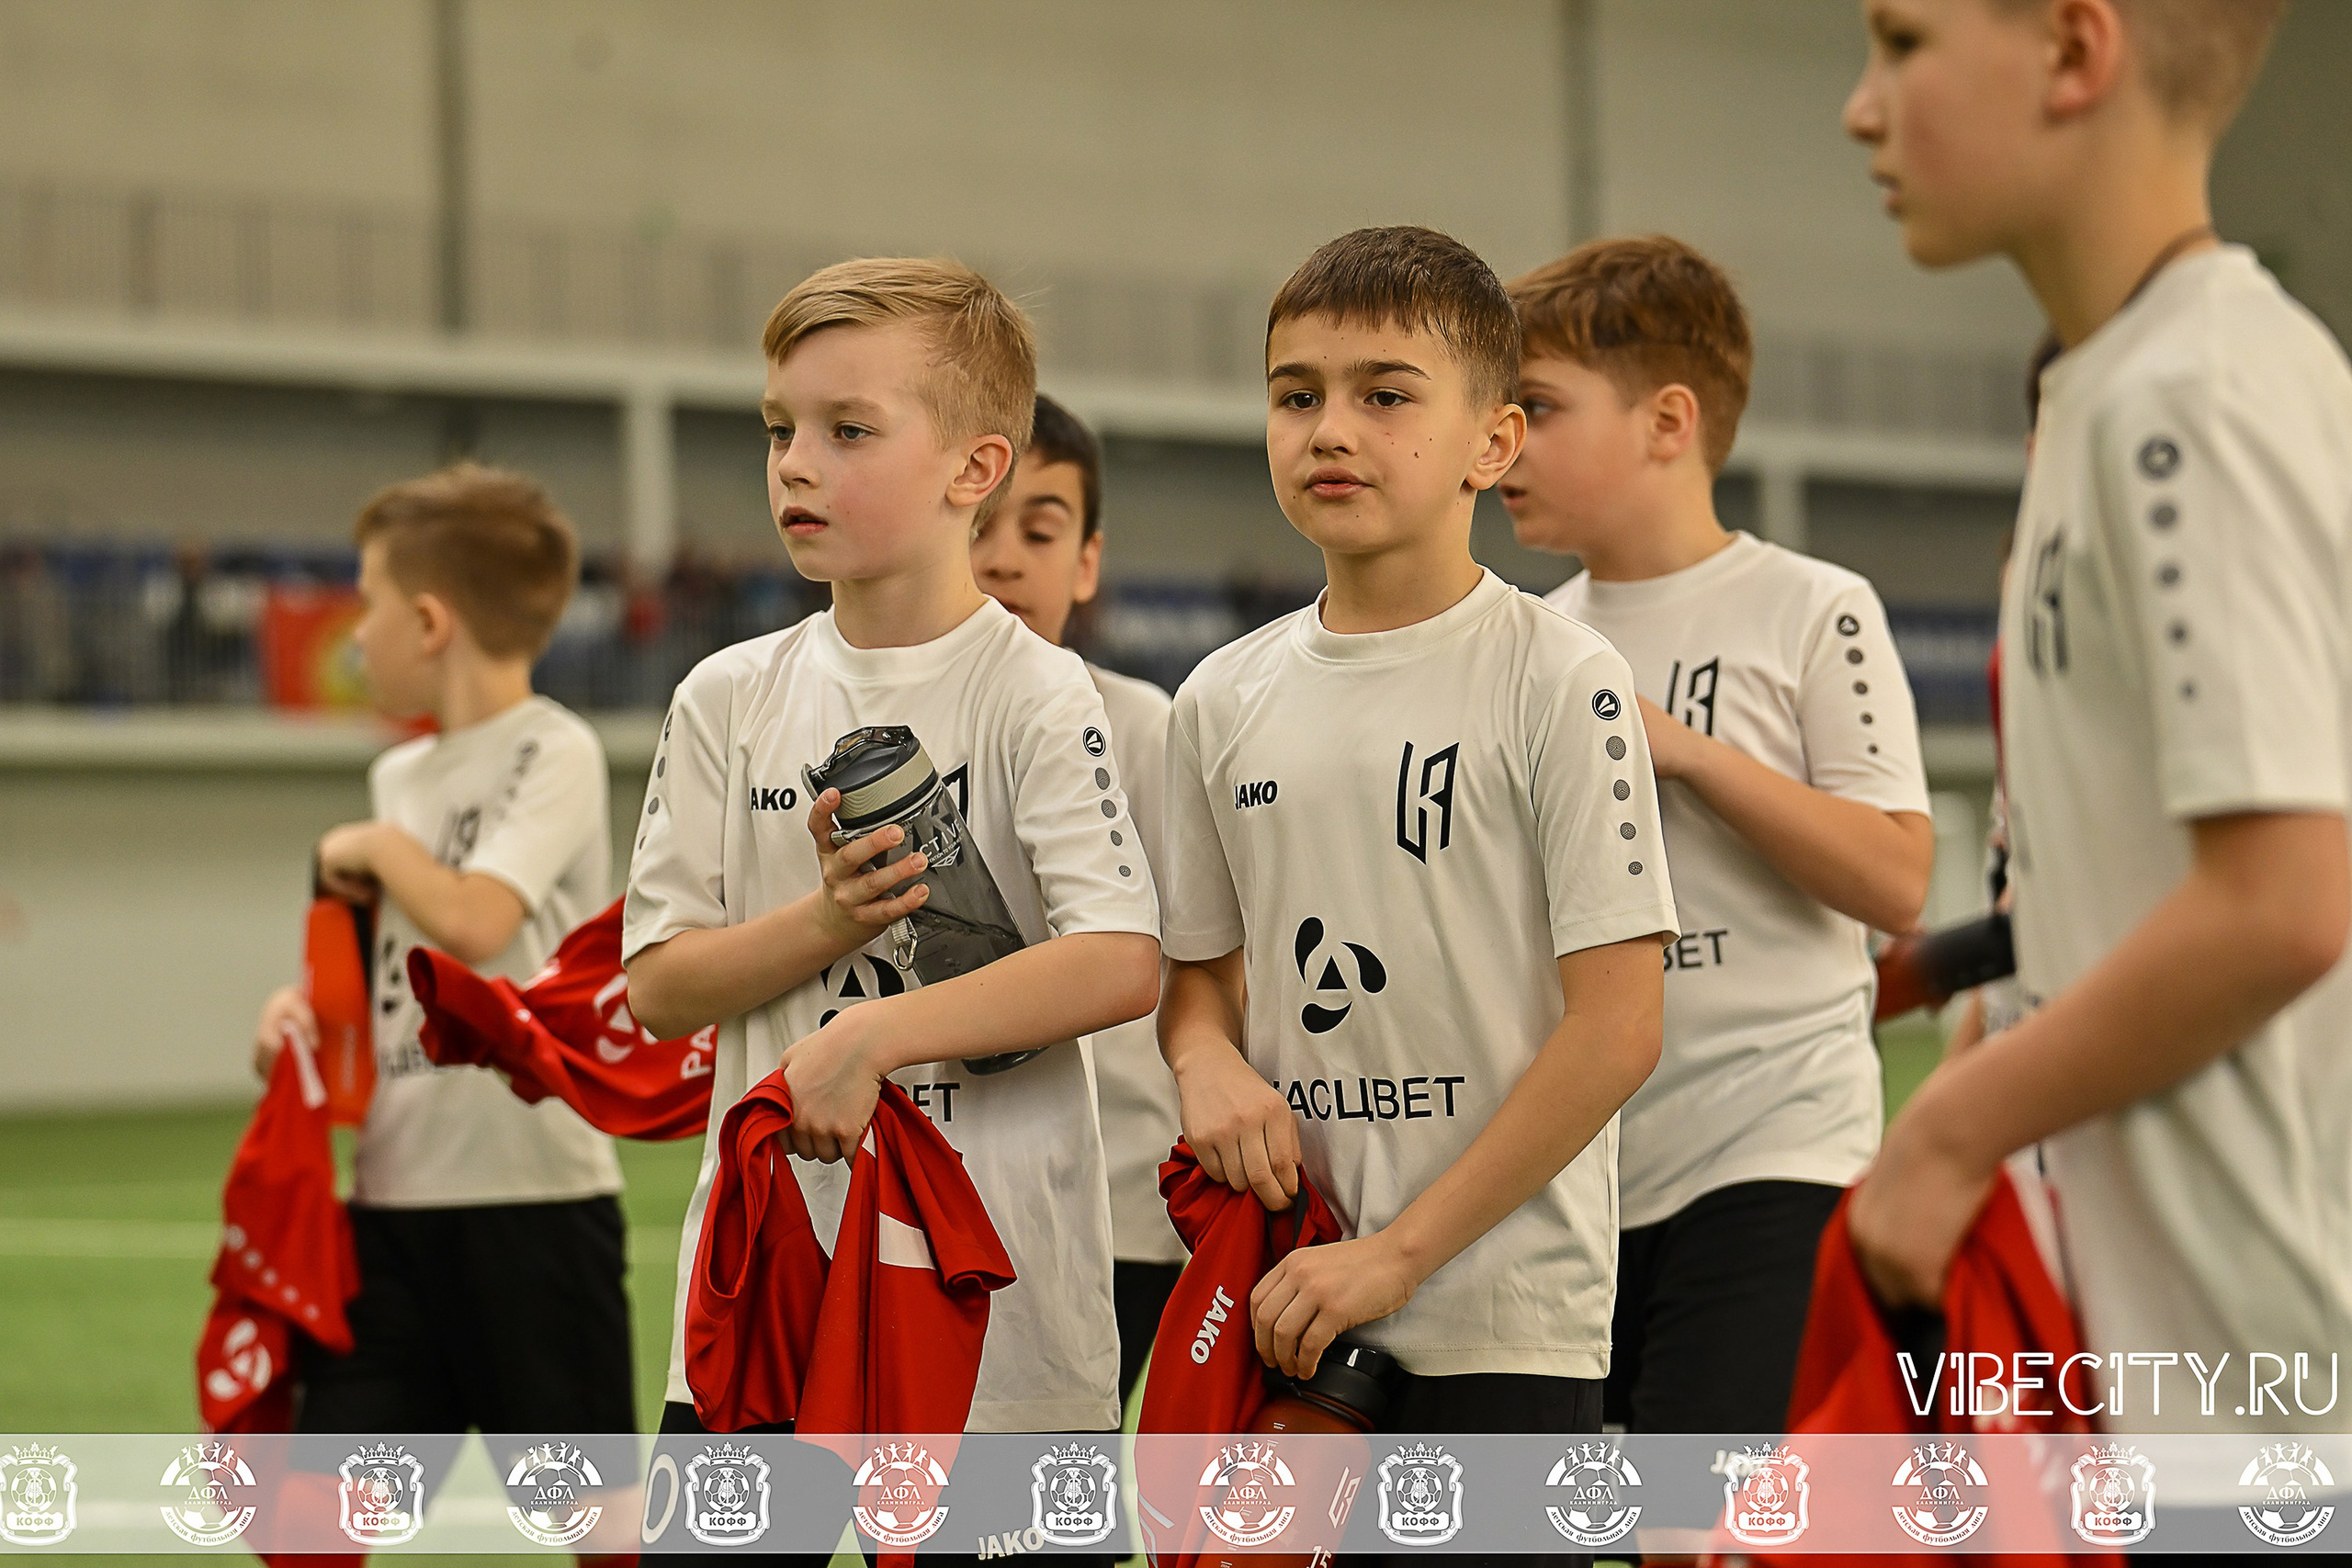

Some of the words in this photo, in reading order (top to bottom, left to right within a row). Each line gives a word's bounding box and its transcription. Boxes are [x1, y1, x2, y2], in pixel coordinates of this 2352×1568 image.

[751, 786, 797, 811] AKO
[1234, 780, 1278, 810] JAKO
[919, 818, 963, 858] CTIVE
[1272, 1076, 1466, 1122] АСЦВЕТ
[1191, 1285, 1235, 1364] JAKO
[978, 1527, 1045, 1561] JAKO
